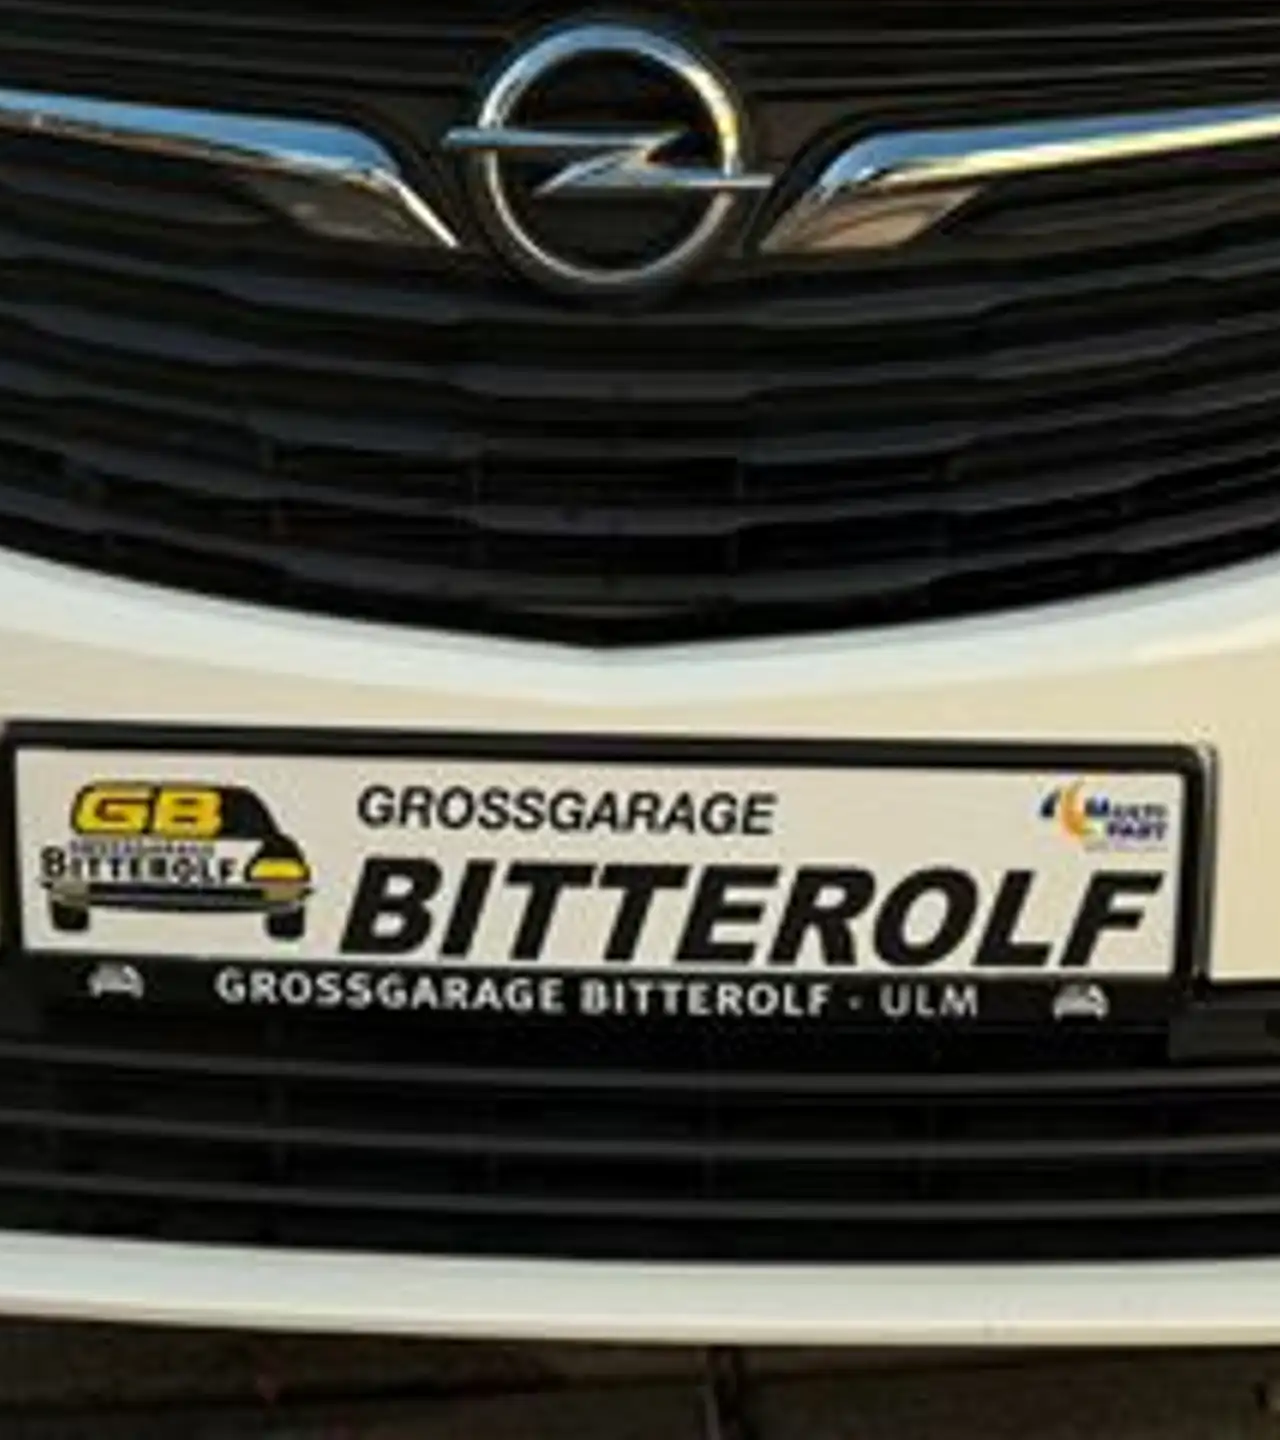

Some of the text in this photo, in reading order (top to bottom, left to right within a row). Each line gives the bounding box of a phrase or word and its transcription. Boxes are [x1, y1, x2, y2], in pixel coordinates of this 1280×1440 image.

[71, 782, 224, 837] GB
[357, 786, 777, 836] GROSSGARAGE
[40, 847, 239, 886] BITTEROLF
[338, 856, 1166, 968] BITTEROLF
[215, 969, 564, 1015] GROSSGARAGE
[580, 978, 832, 1017] BITTEROLF
[879, 984, 979, 1018] ULM
